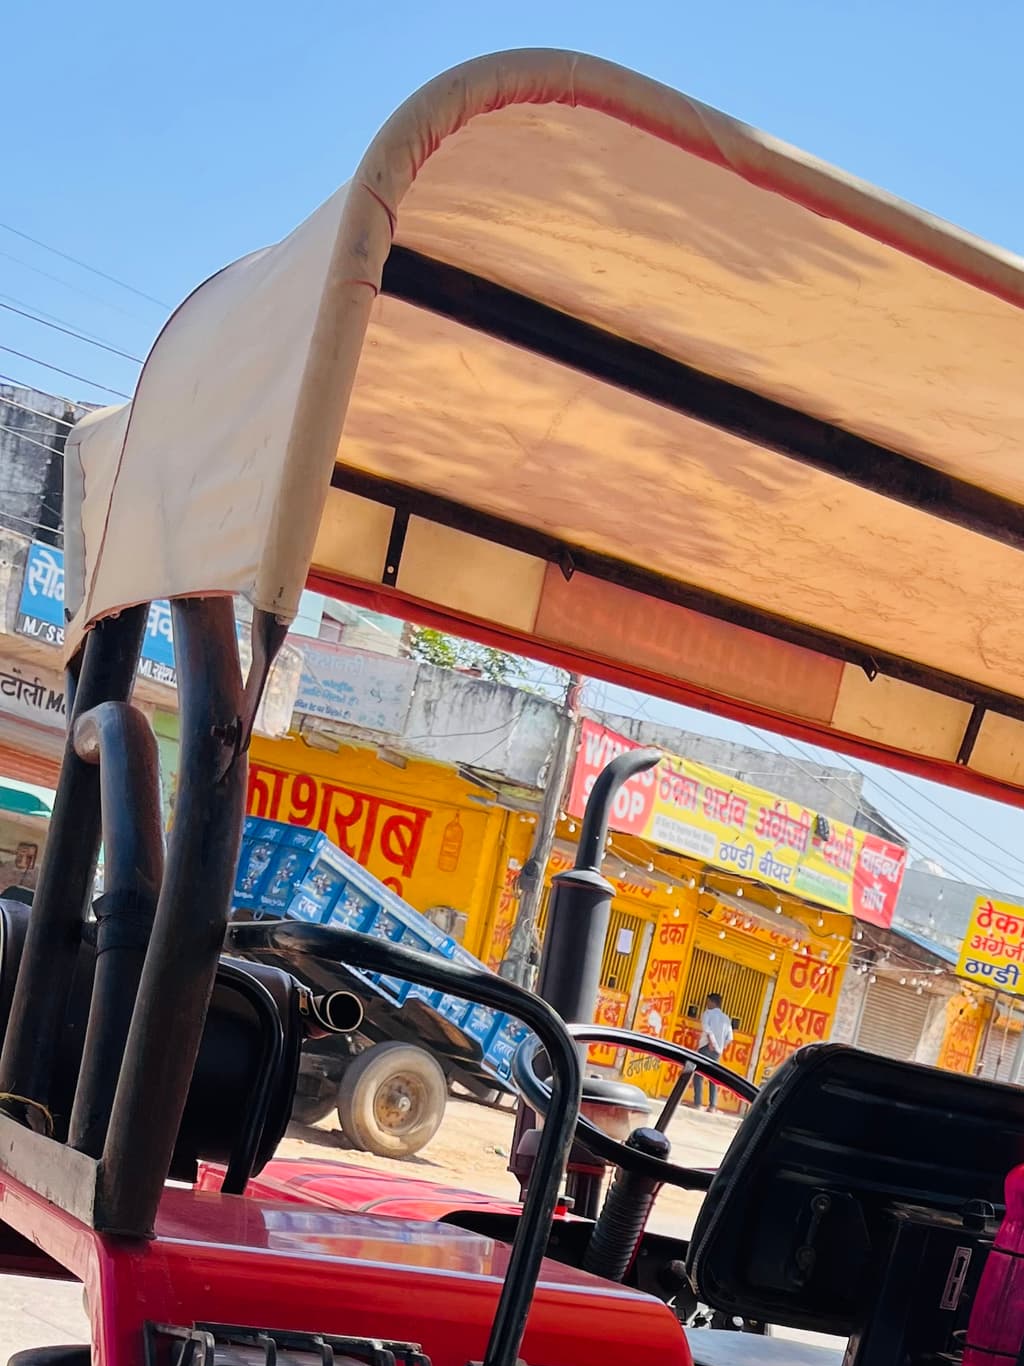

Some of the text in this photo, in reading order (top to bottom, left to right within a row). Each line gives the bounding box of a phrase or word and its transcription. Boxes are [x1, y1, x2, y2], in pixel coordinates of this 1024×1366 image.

[582, 774, 645, 822] SOP
[718, 842, 755, 870] ठण्डी
[790, 944, 840, 998] ठेका
[965, 957, 1021, 986] ठण्डी
[773, 998, 831, 1038] शराब
